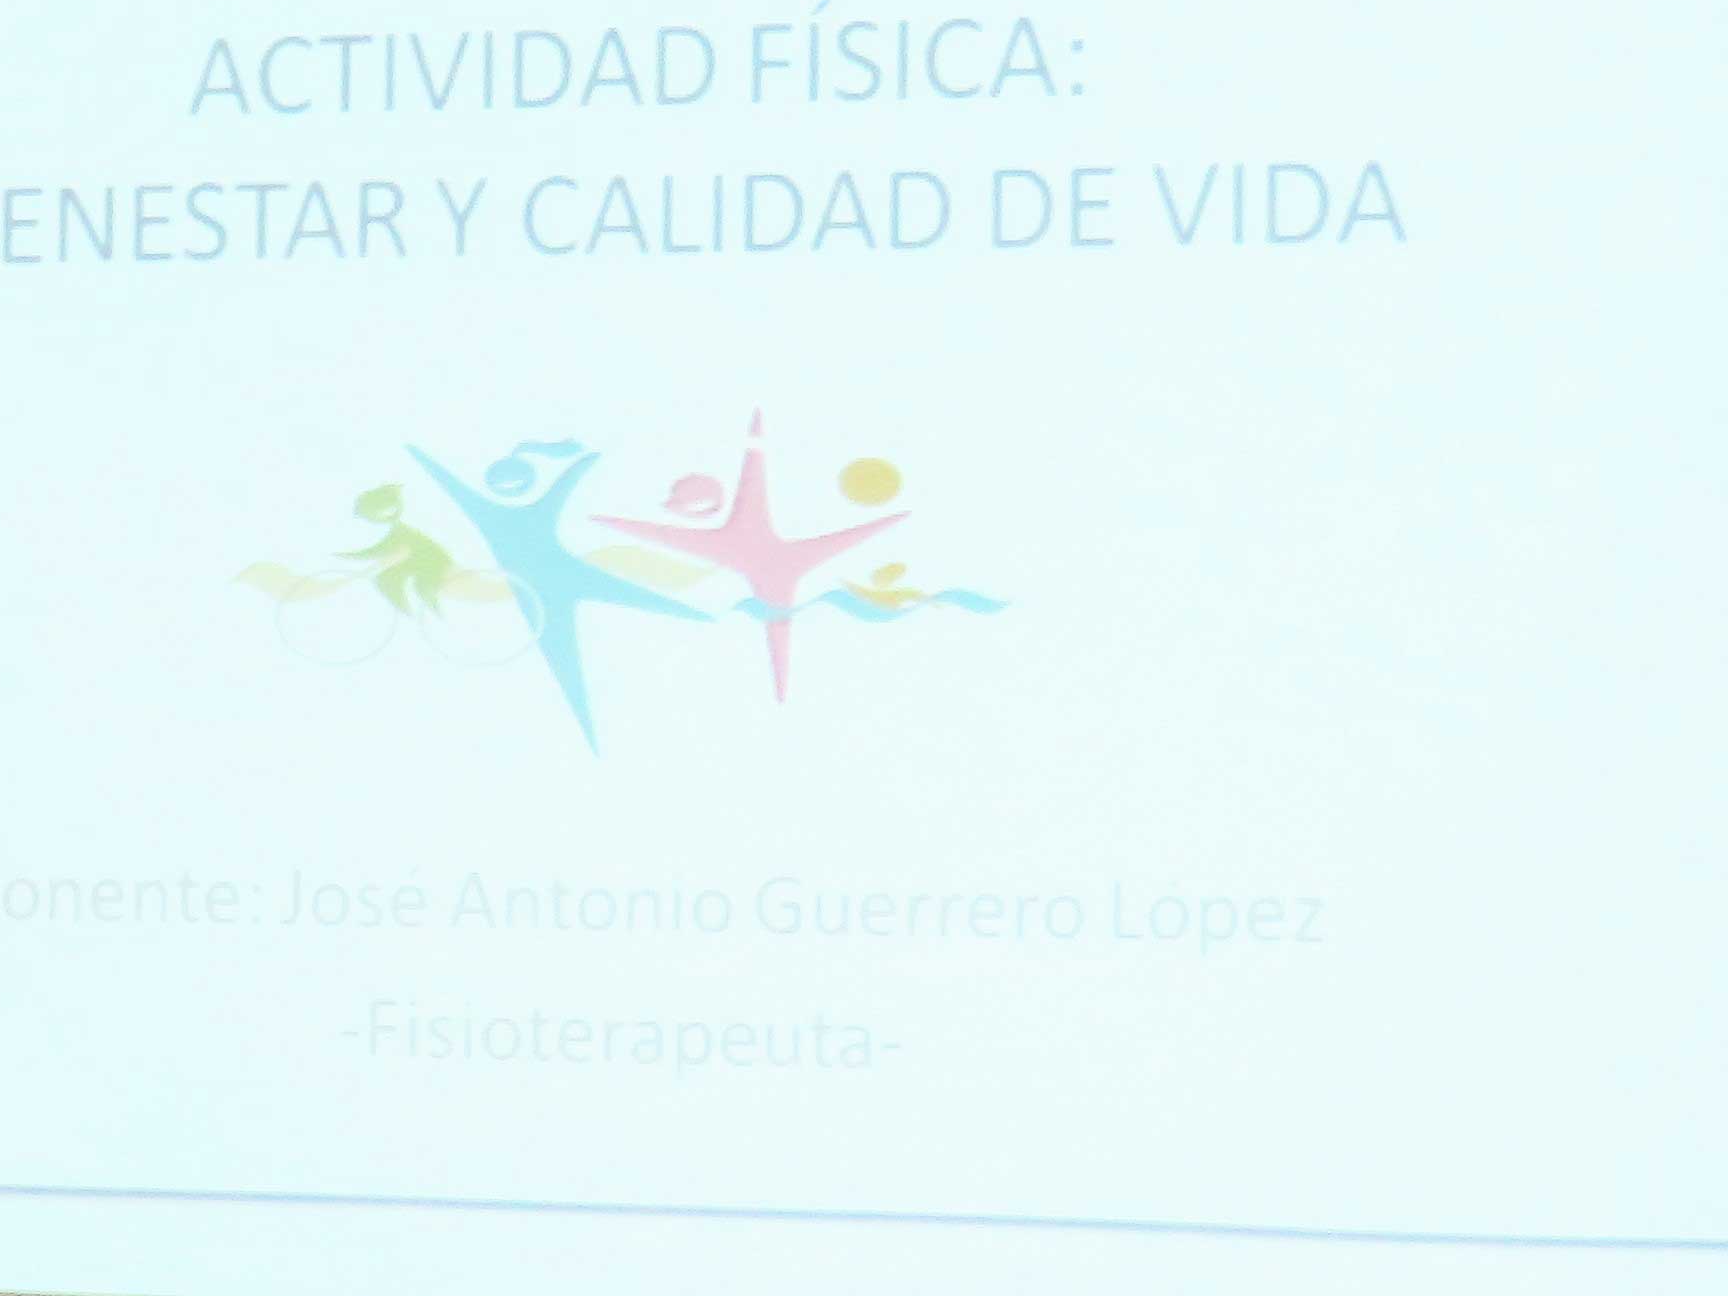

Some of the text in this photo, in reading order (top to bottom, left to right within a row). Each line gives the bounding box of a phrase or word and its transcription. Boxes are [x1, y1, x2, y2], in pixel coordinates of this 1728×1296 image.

[191, 23, 716, 114] ACTIVIDAD
[435, 177, 489, 257] Y
[522, 170, 952, 258] CALIDAD
[991, 167, 1115, 250] DE
[1153, 159, 1408, 245] VIDA
[279, 864, 429, 927] José
[448, 870, 736, 934] Antonio
[755, 873, 1085, 939] Guerrero
[338, 998, 905, 1078] -Fisioterapeuta-
